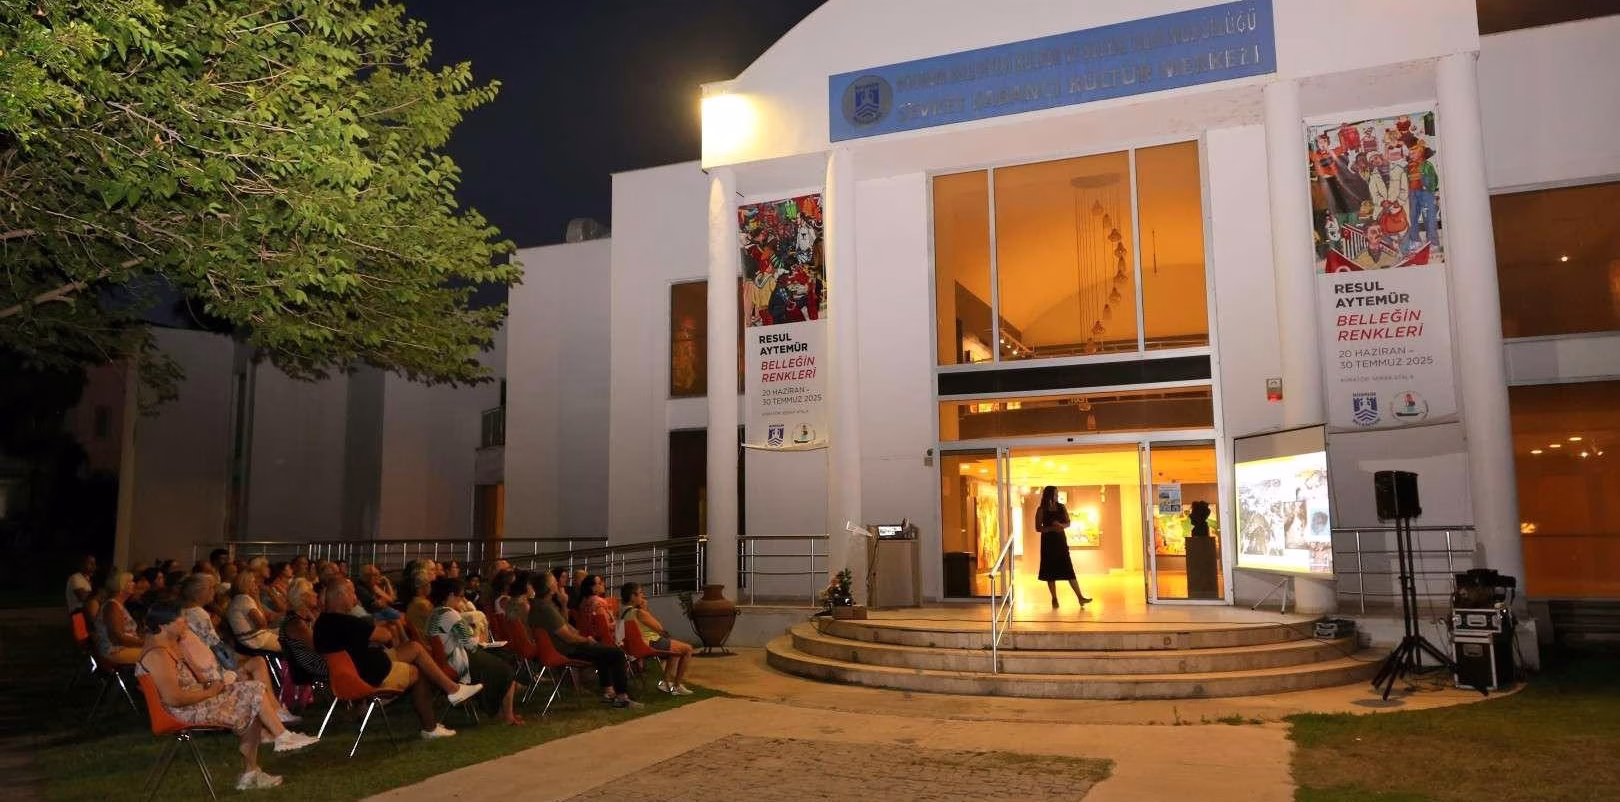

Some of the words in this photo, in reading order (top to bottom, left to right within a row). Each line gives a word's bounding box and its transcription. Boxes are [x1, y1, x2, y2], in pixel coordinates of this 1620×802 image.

[1334, 281, 1384, 294] RESUL
[1335, 292, 1410, 308] AYTEMÜR
[1337, 308, 1421, 326] BELLEĞİN
[759, 333, 792, 344] RESUL
[1338, 323, 1424, 342] RENKLERİ
[760, 342, 808, 356] AYTEMÜR
[1339, 350, 1351, 358] 20
[1355, 347, 1406, 358] HAZİRAN
[761, 356, 815, 371] BELLEĞİN
[1340, 361, 1353, 369] 30
[1355, 357, 1402, 369] TEMMUZ
[1407, 356, 1434, 366] 2025
[762, 367, 816, 382] RENKLERİ
[772, 387, 805, 396] HAZİRAN
[772, 396, 802, 405] TEMMUZ
[804, 394, 822, 403] 2025
